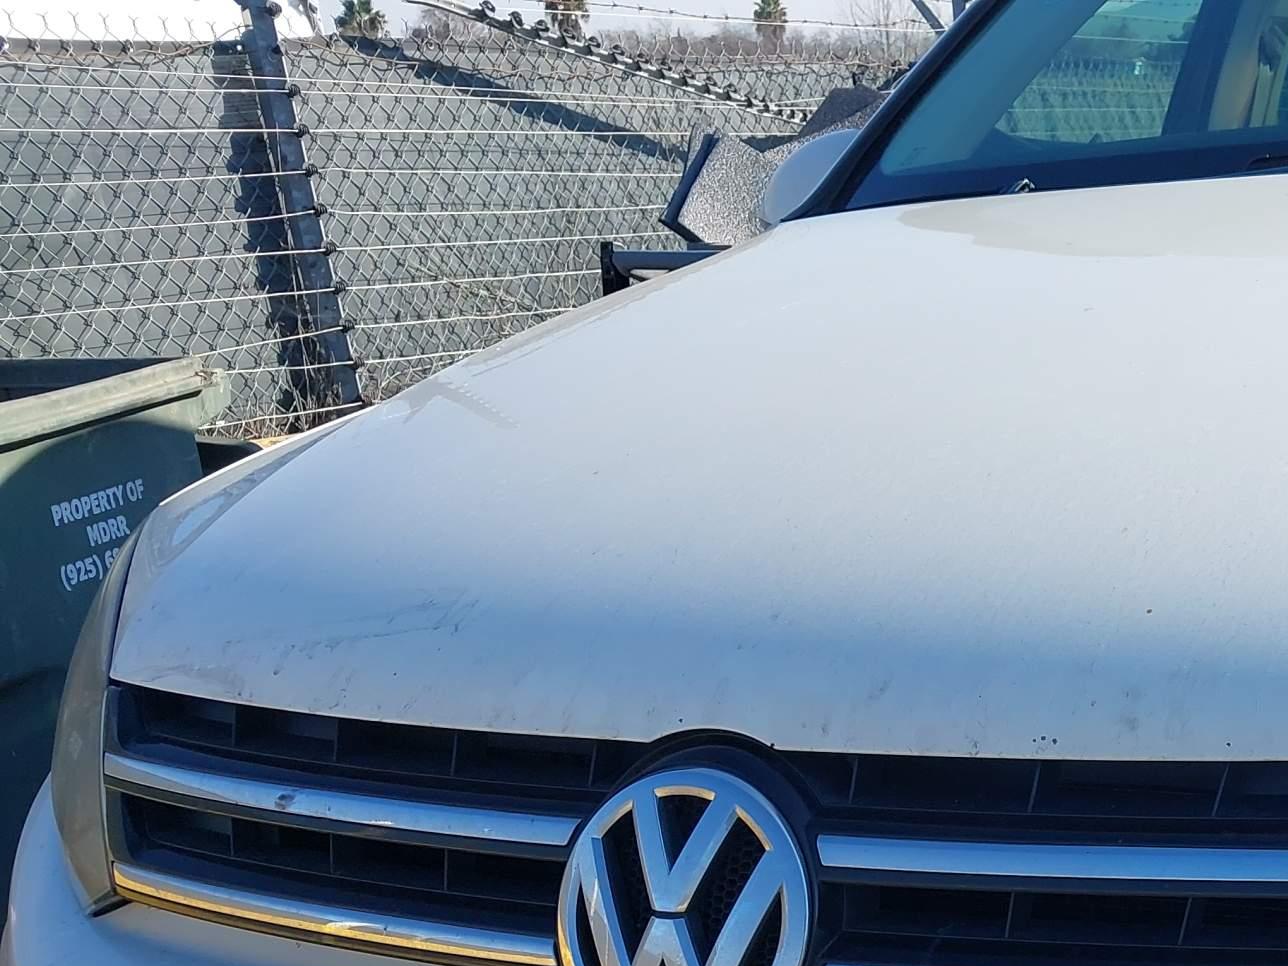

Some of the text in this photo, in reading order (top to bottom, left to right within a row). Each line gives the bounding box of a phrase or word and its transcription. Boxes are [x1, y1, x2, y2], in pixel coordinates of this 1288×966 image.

[51, 478, 144, 526] PROPERTY OF
[86, 515, 130, 546] MDRR
[60, 554, 103, 591] (925)
